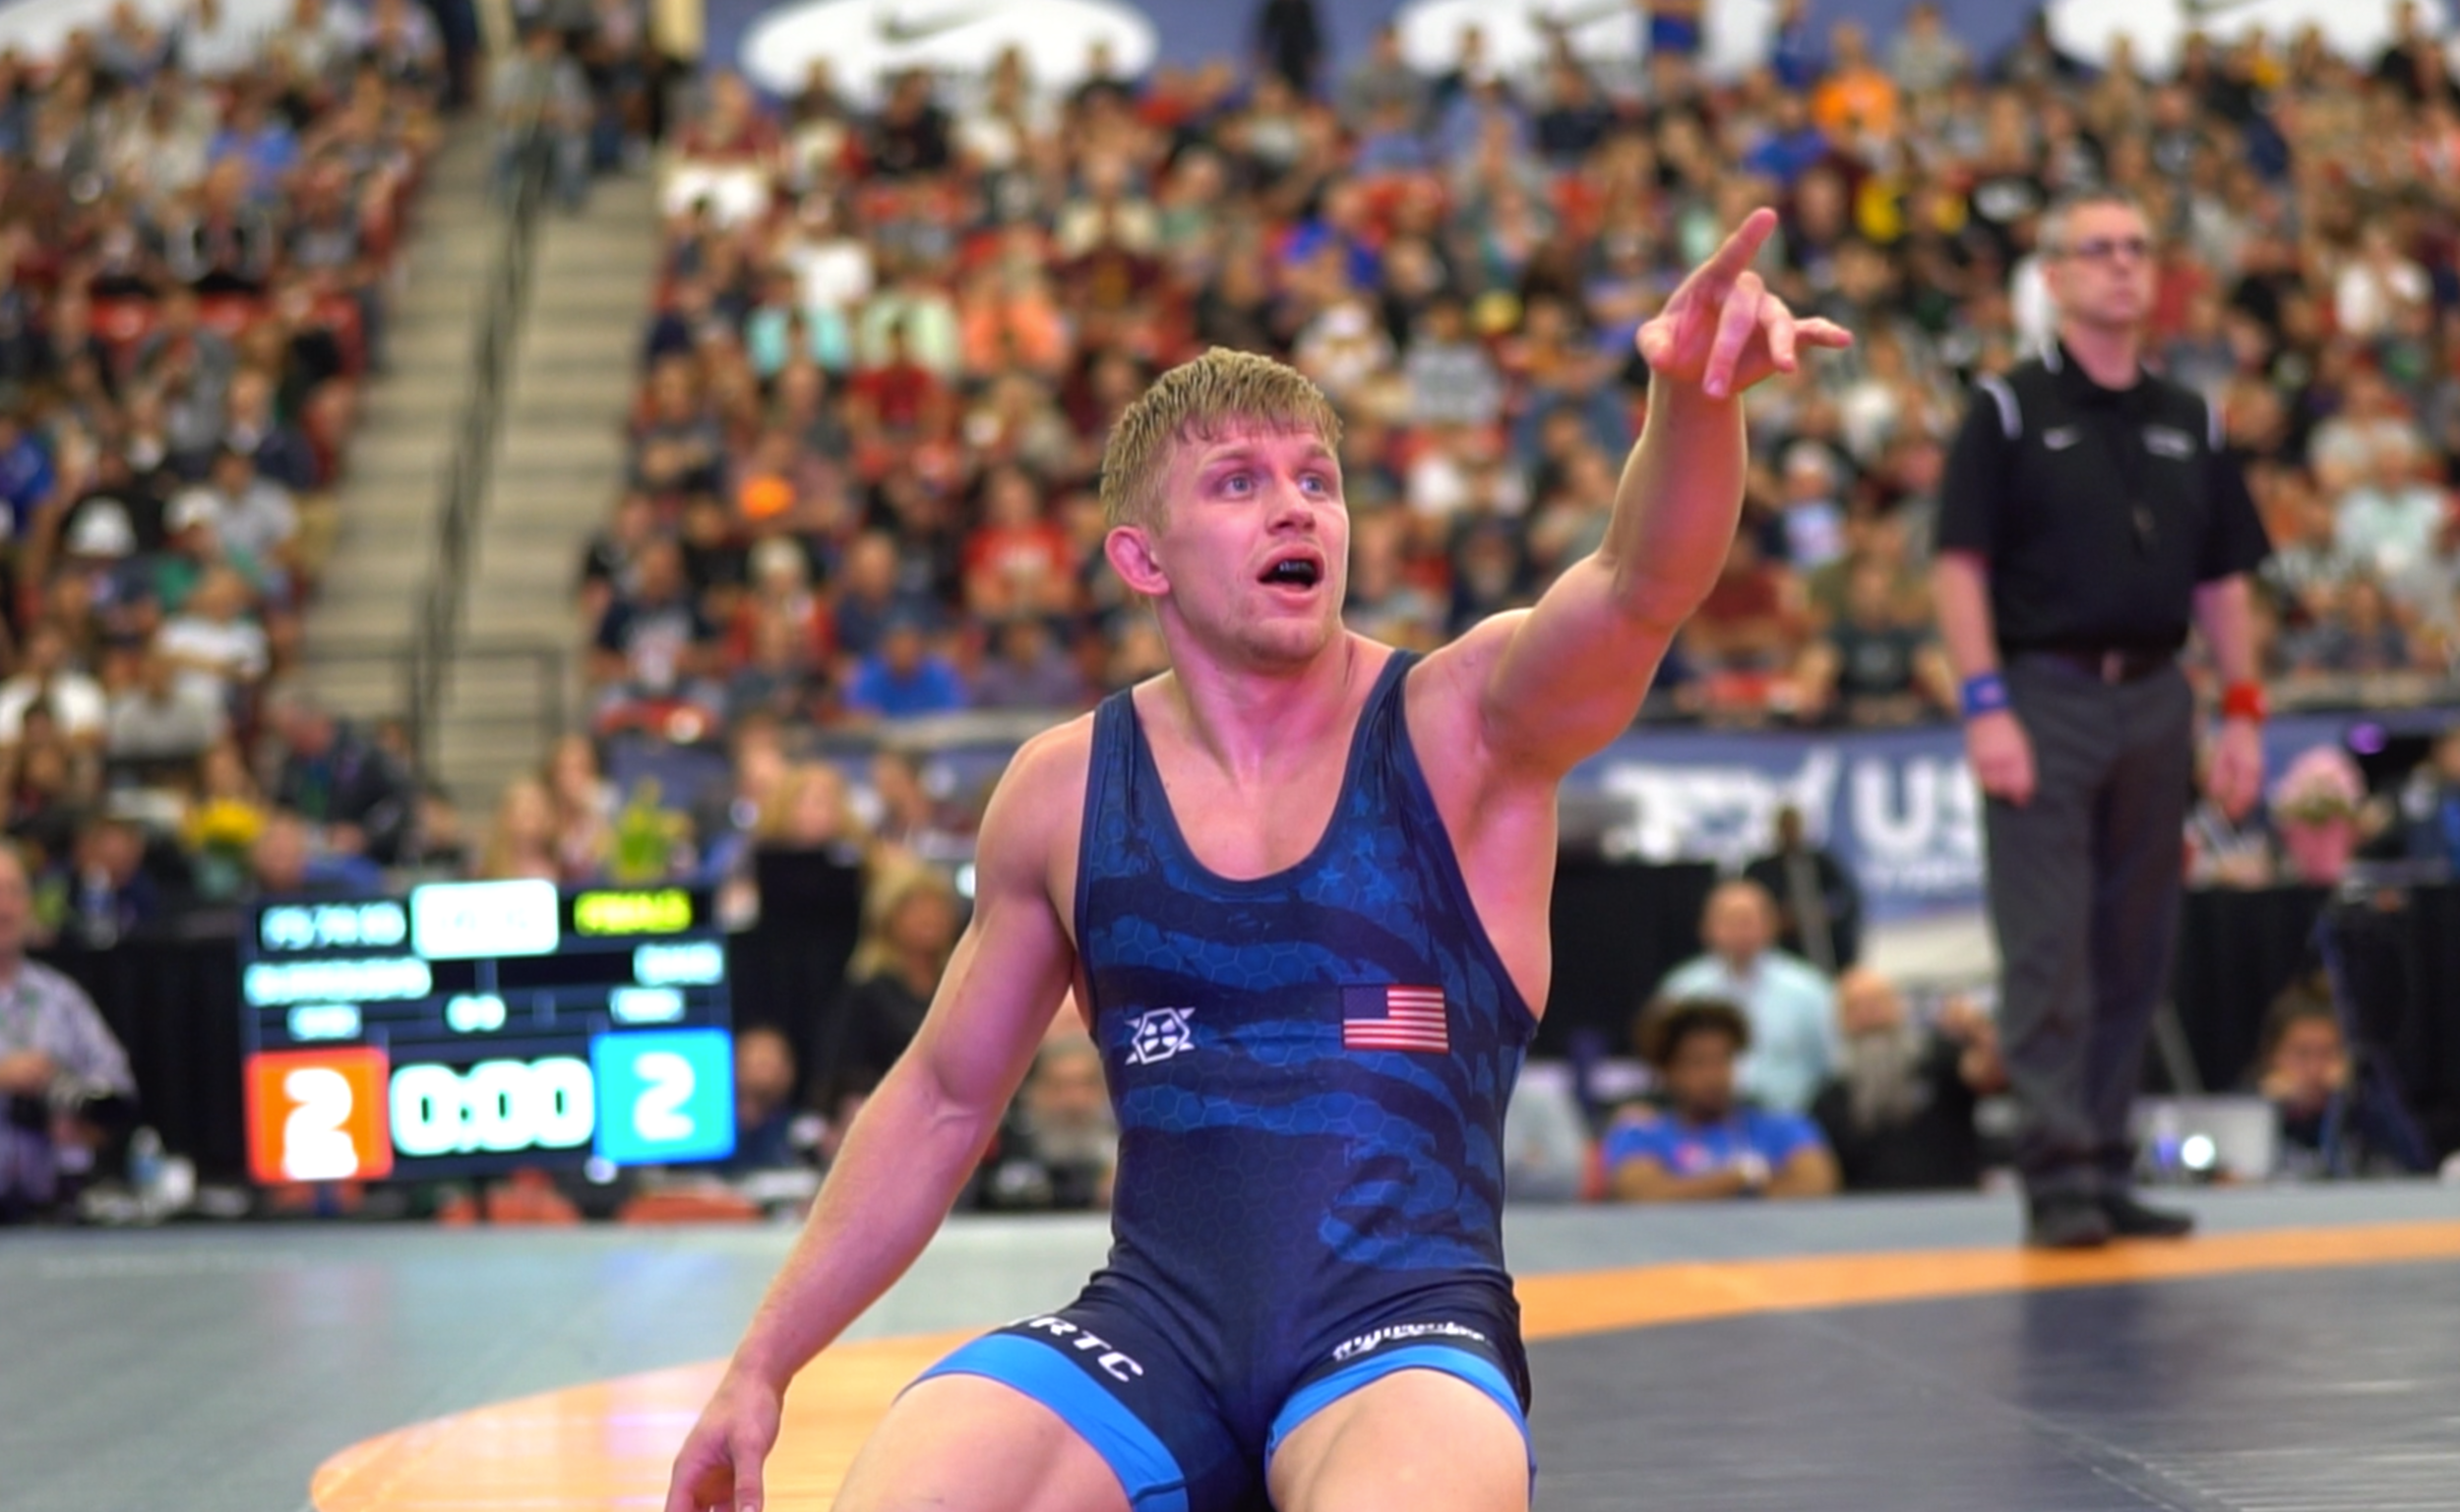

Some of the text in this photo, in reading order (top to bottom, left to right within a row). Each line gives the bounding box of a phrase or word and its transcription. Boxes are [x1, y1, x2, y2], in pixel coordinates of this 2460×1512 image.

[283, 1068, 358, 1173] 2
[390, 1057, 594, 1155] 0:00
[630, 1052, 695, 1141] 2
[1008, 1314, 1144, 1383] RTC
